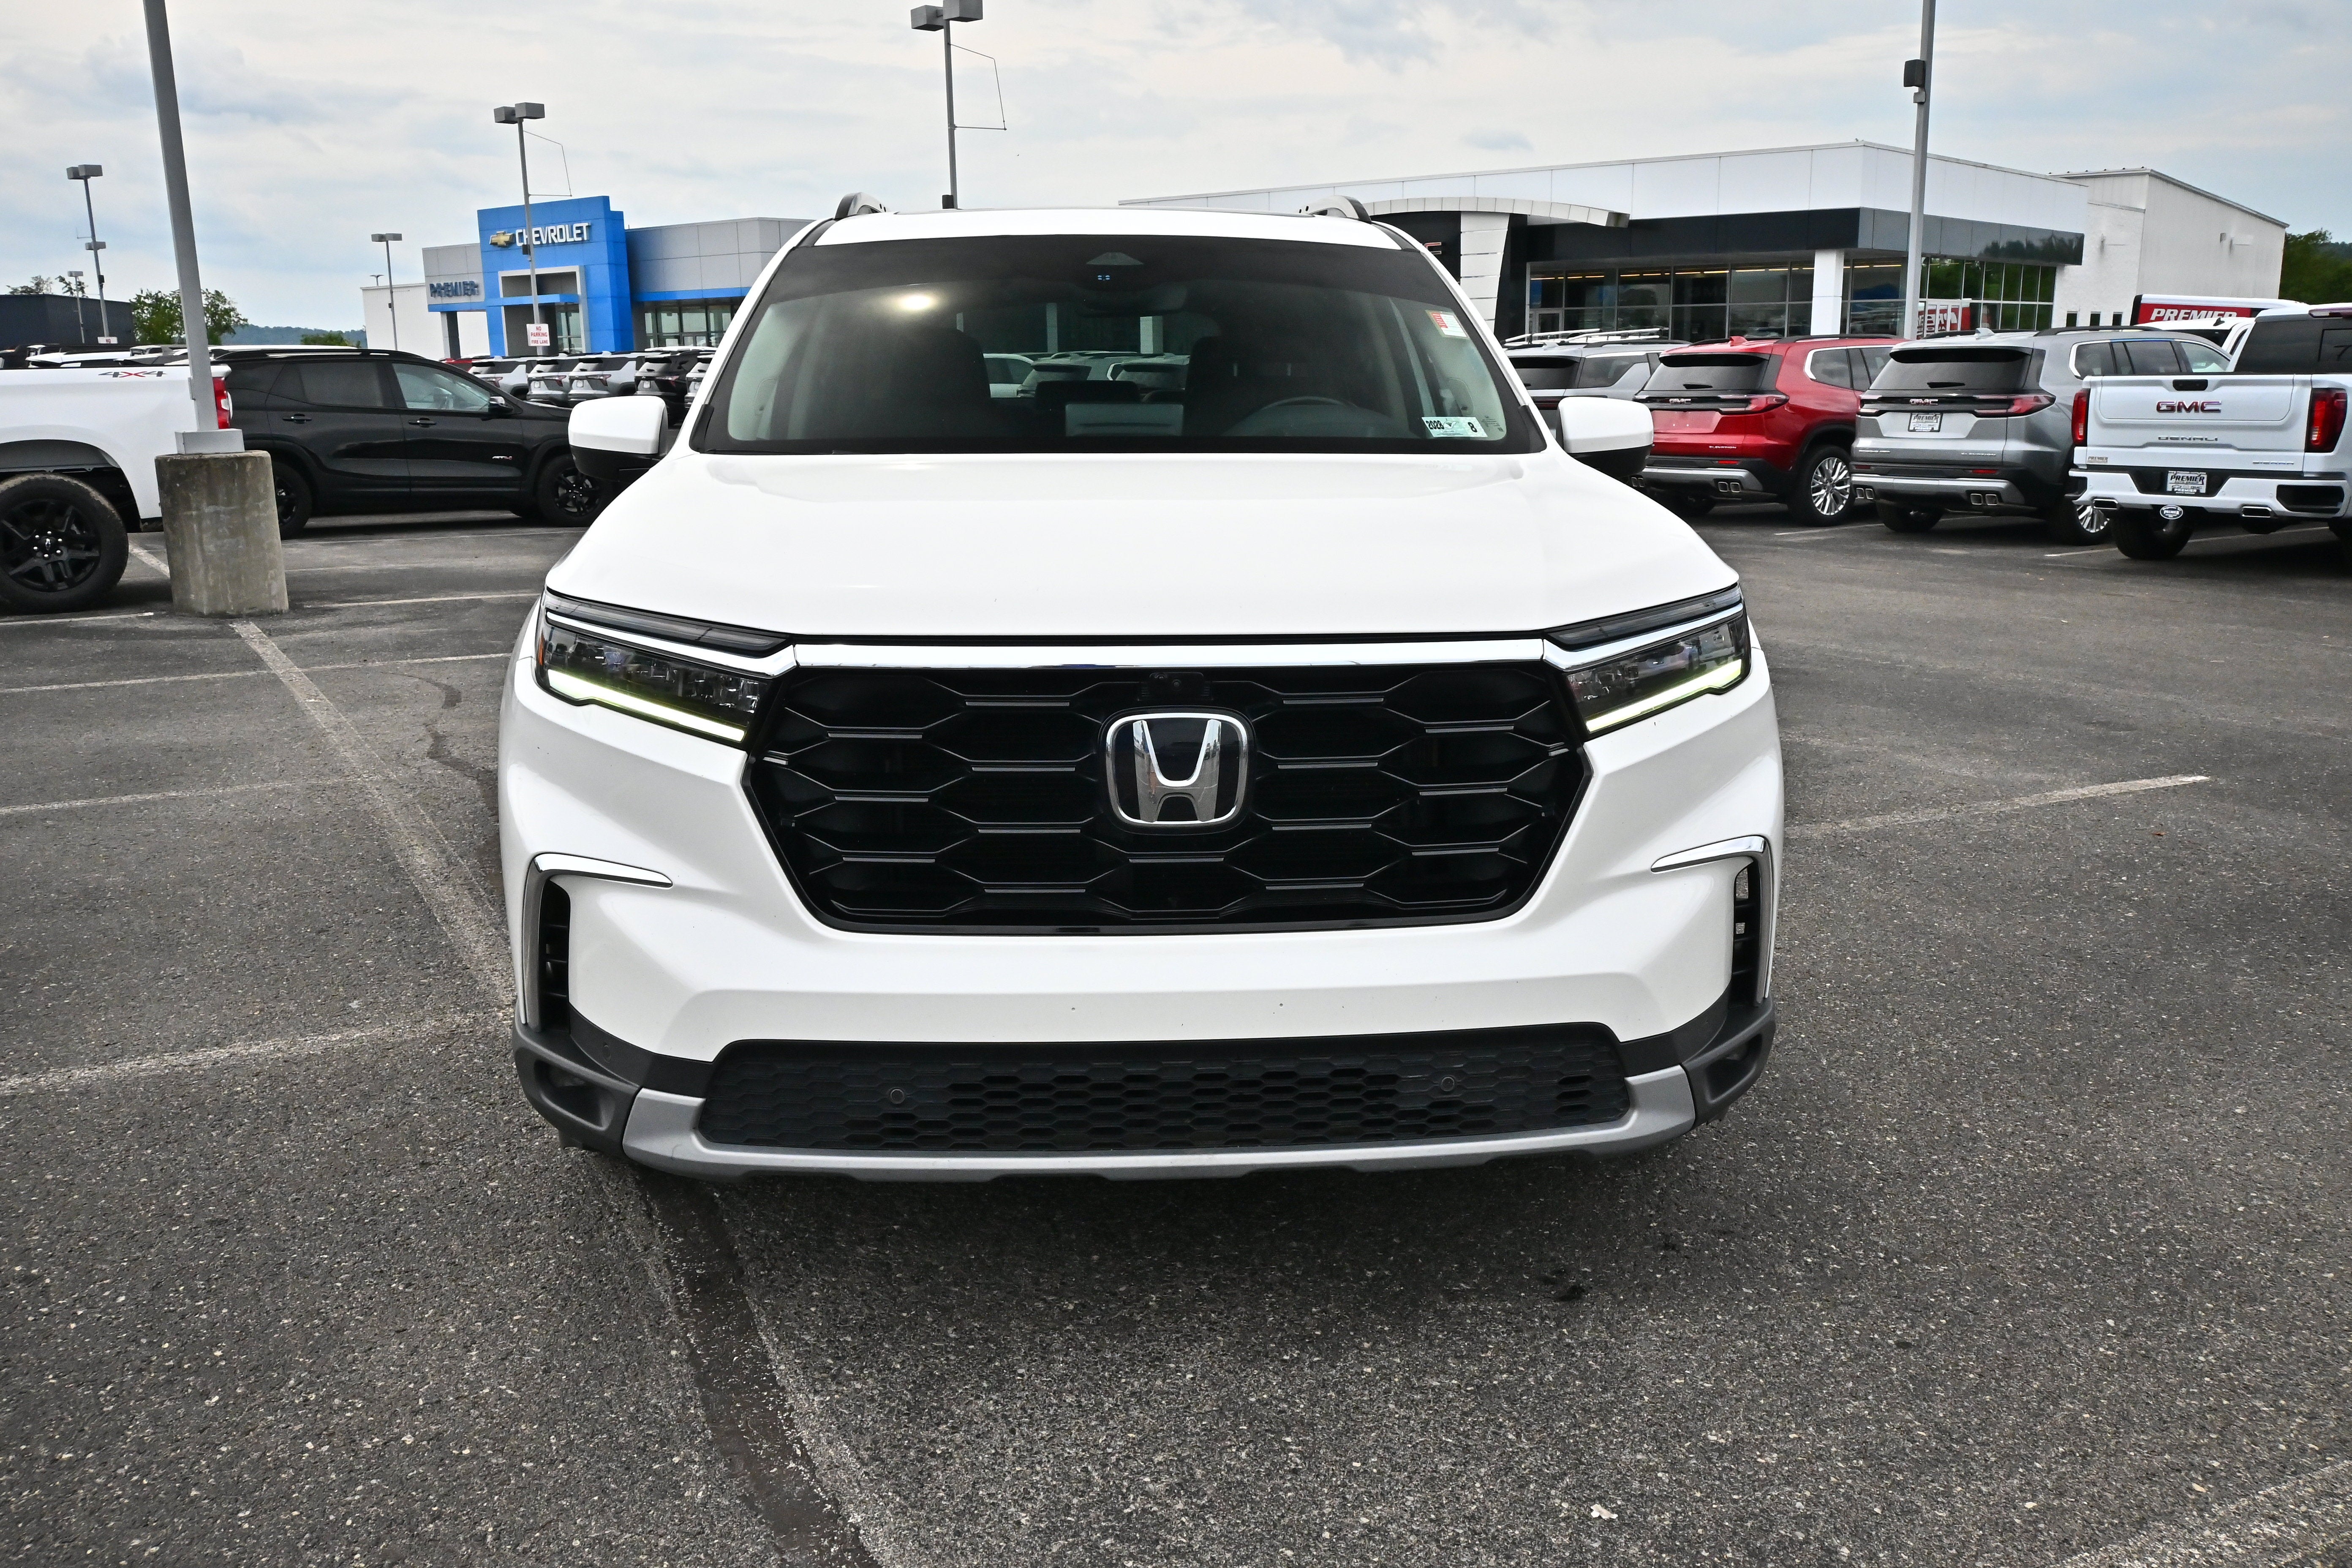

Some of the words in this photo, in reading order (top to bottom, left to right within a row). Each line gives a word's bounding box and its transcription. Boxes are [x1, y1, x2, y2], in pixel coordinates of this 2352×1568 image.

[516, 223, 588, 246] CHEVROLET
[2156, 401, 2222, 413] GMC
[1426, 420, 1444, 430] 2028
[1468, 422, 1478, 433] 8
[2170, 475, 2205, 485] PREMIER
